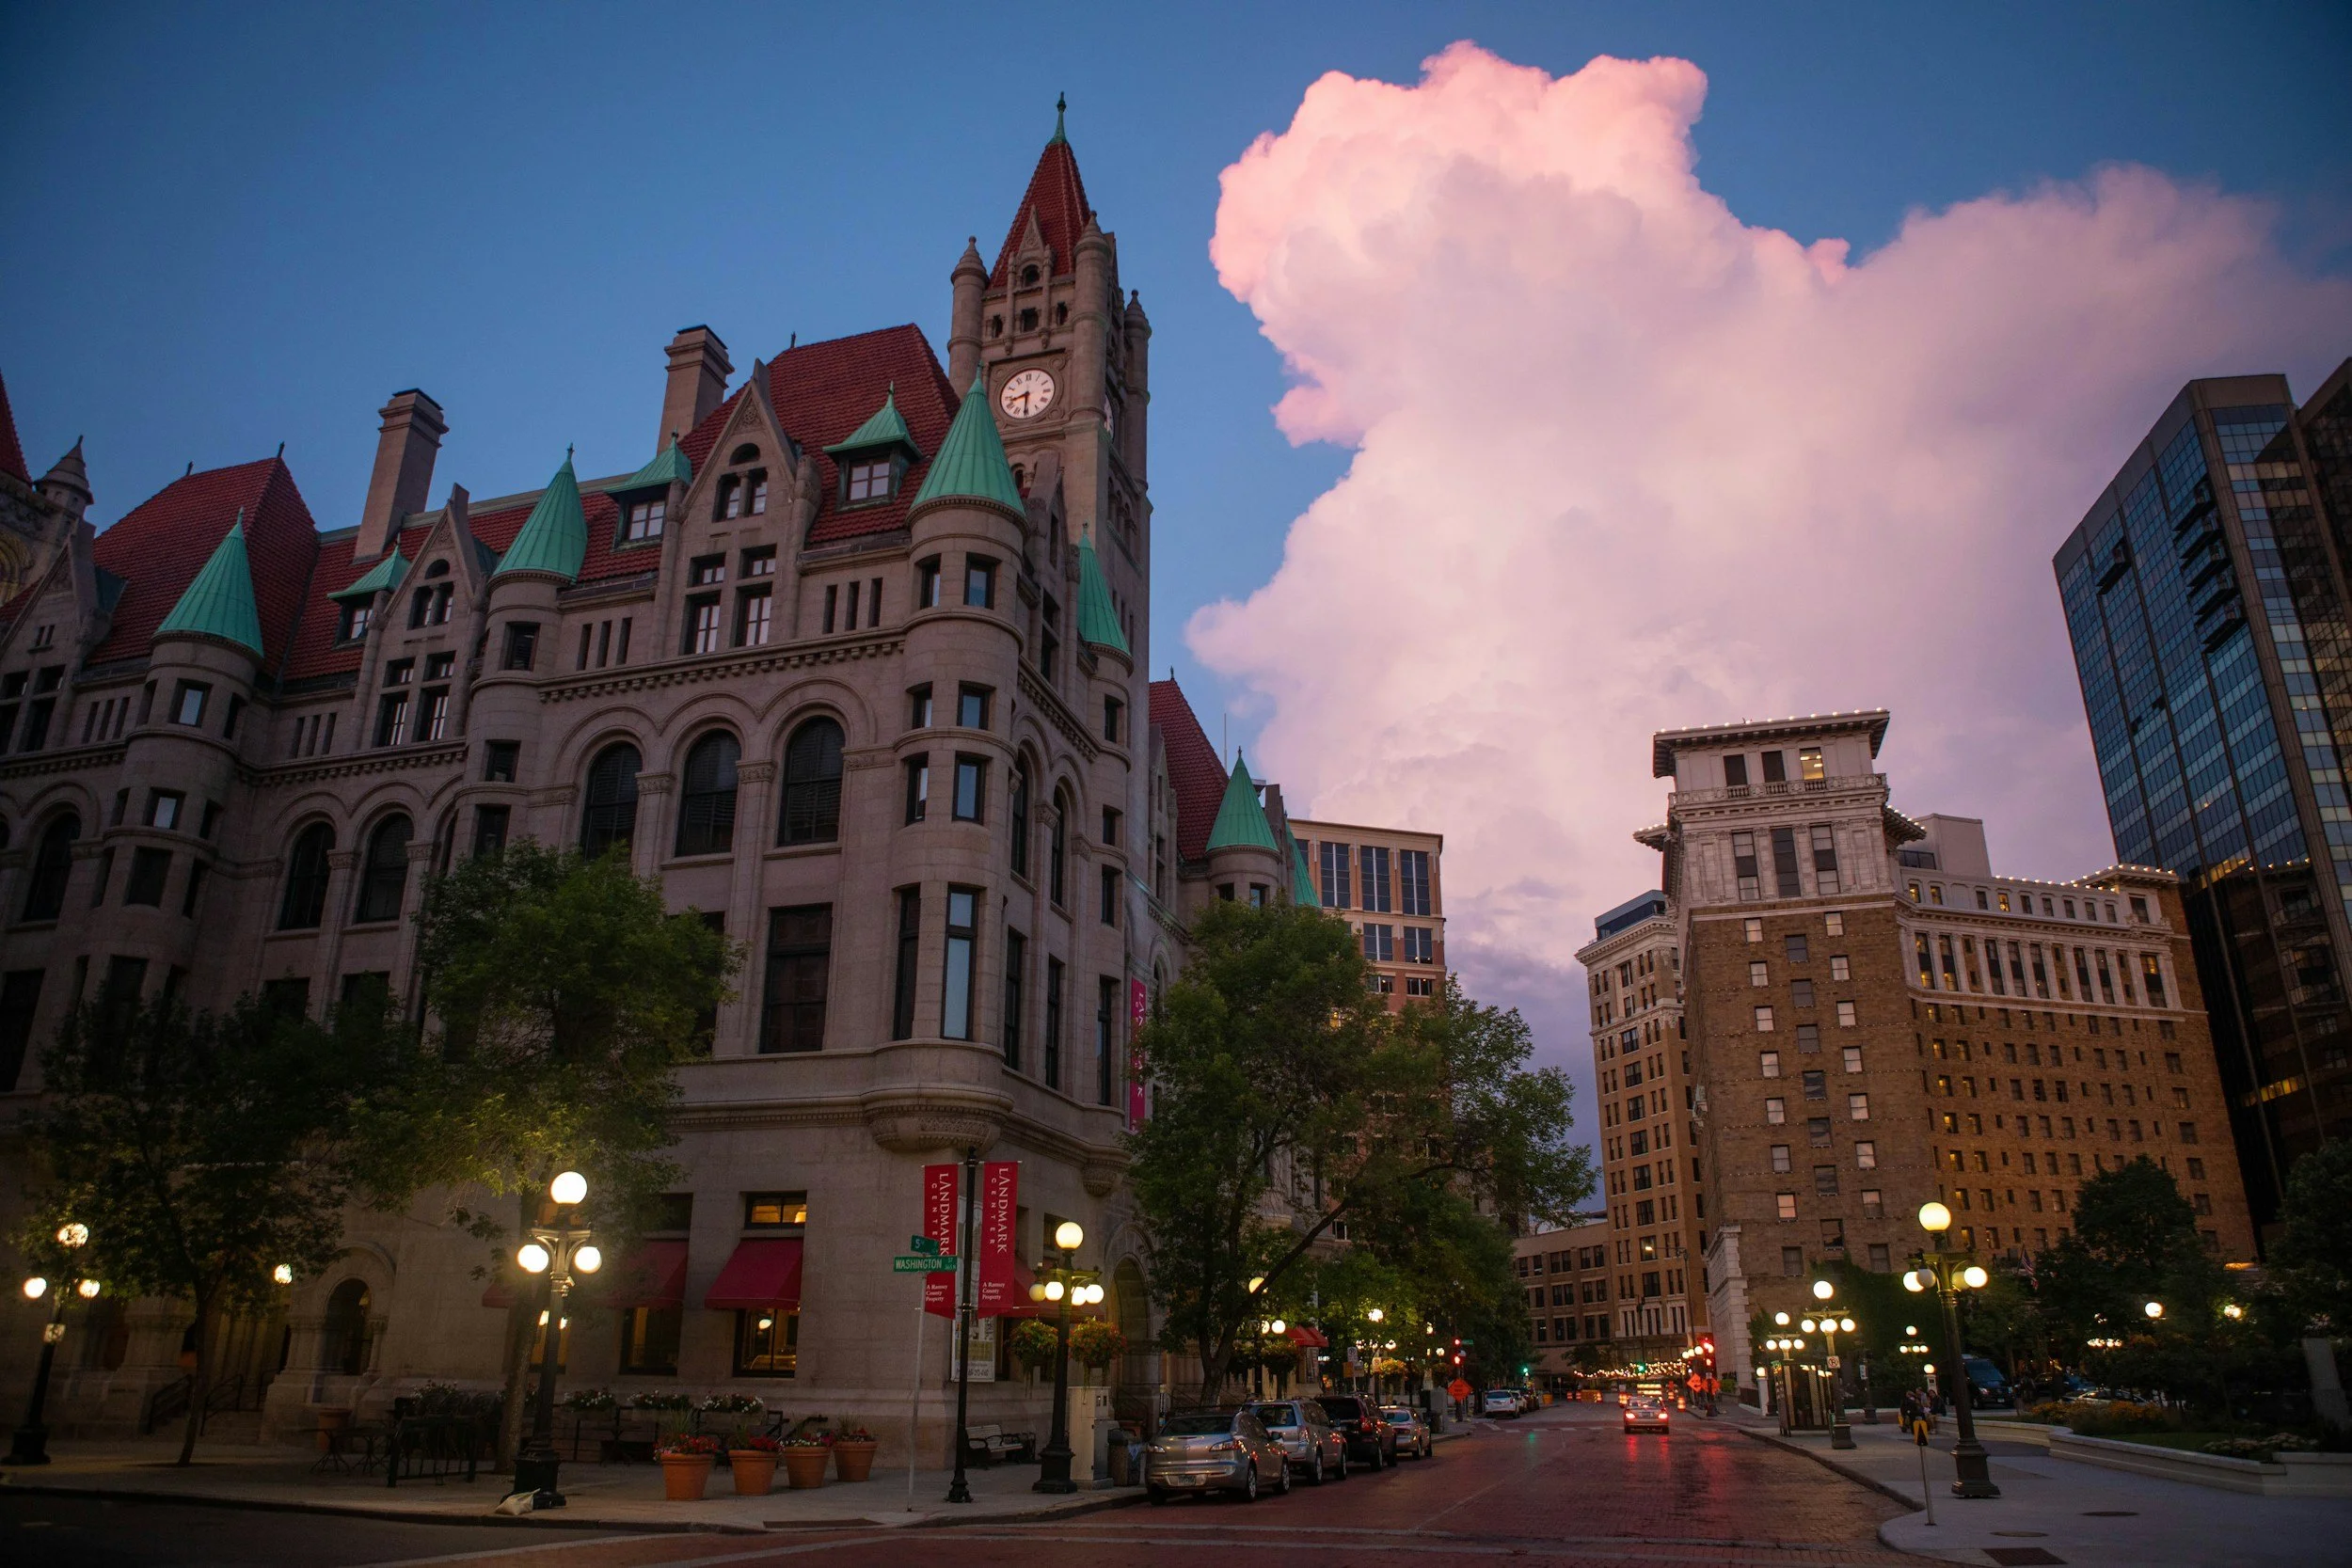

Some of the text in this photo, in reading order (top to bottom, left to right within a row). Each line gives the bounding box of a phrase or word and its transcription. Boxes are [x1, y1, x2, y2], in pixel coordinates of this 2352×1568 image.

[939, 1172, 952, 1256] LANDMARK
[997, 1167, 1010, 1254] LANDMARK
[896, 1259, 942, 1270] WASHINGTON
